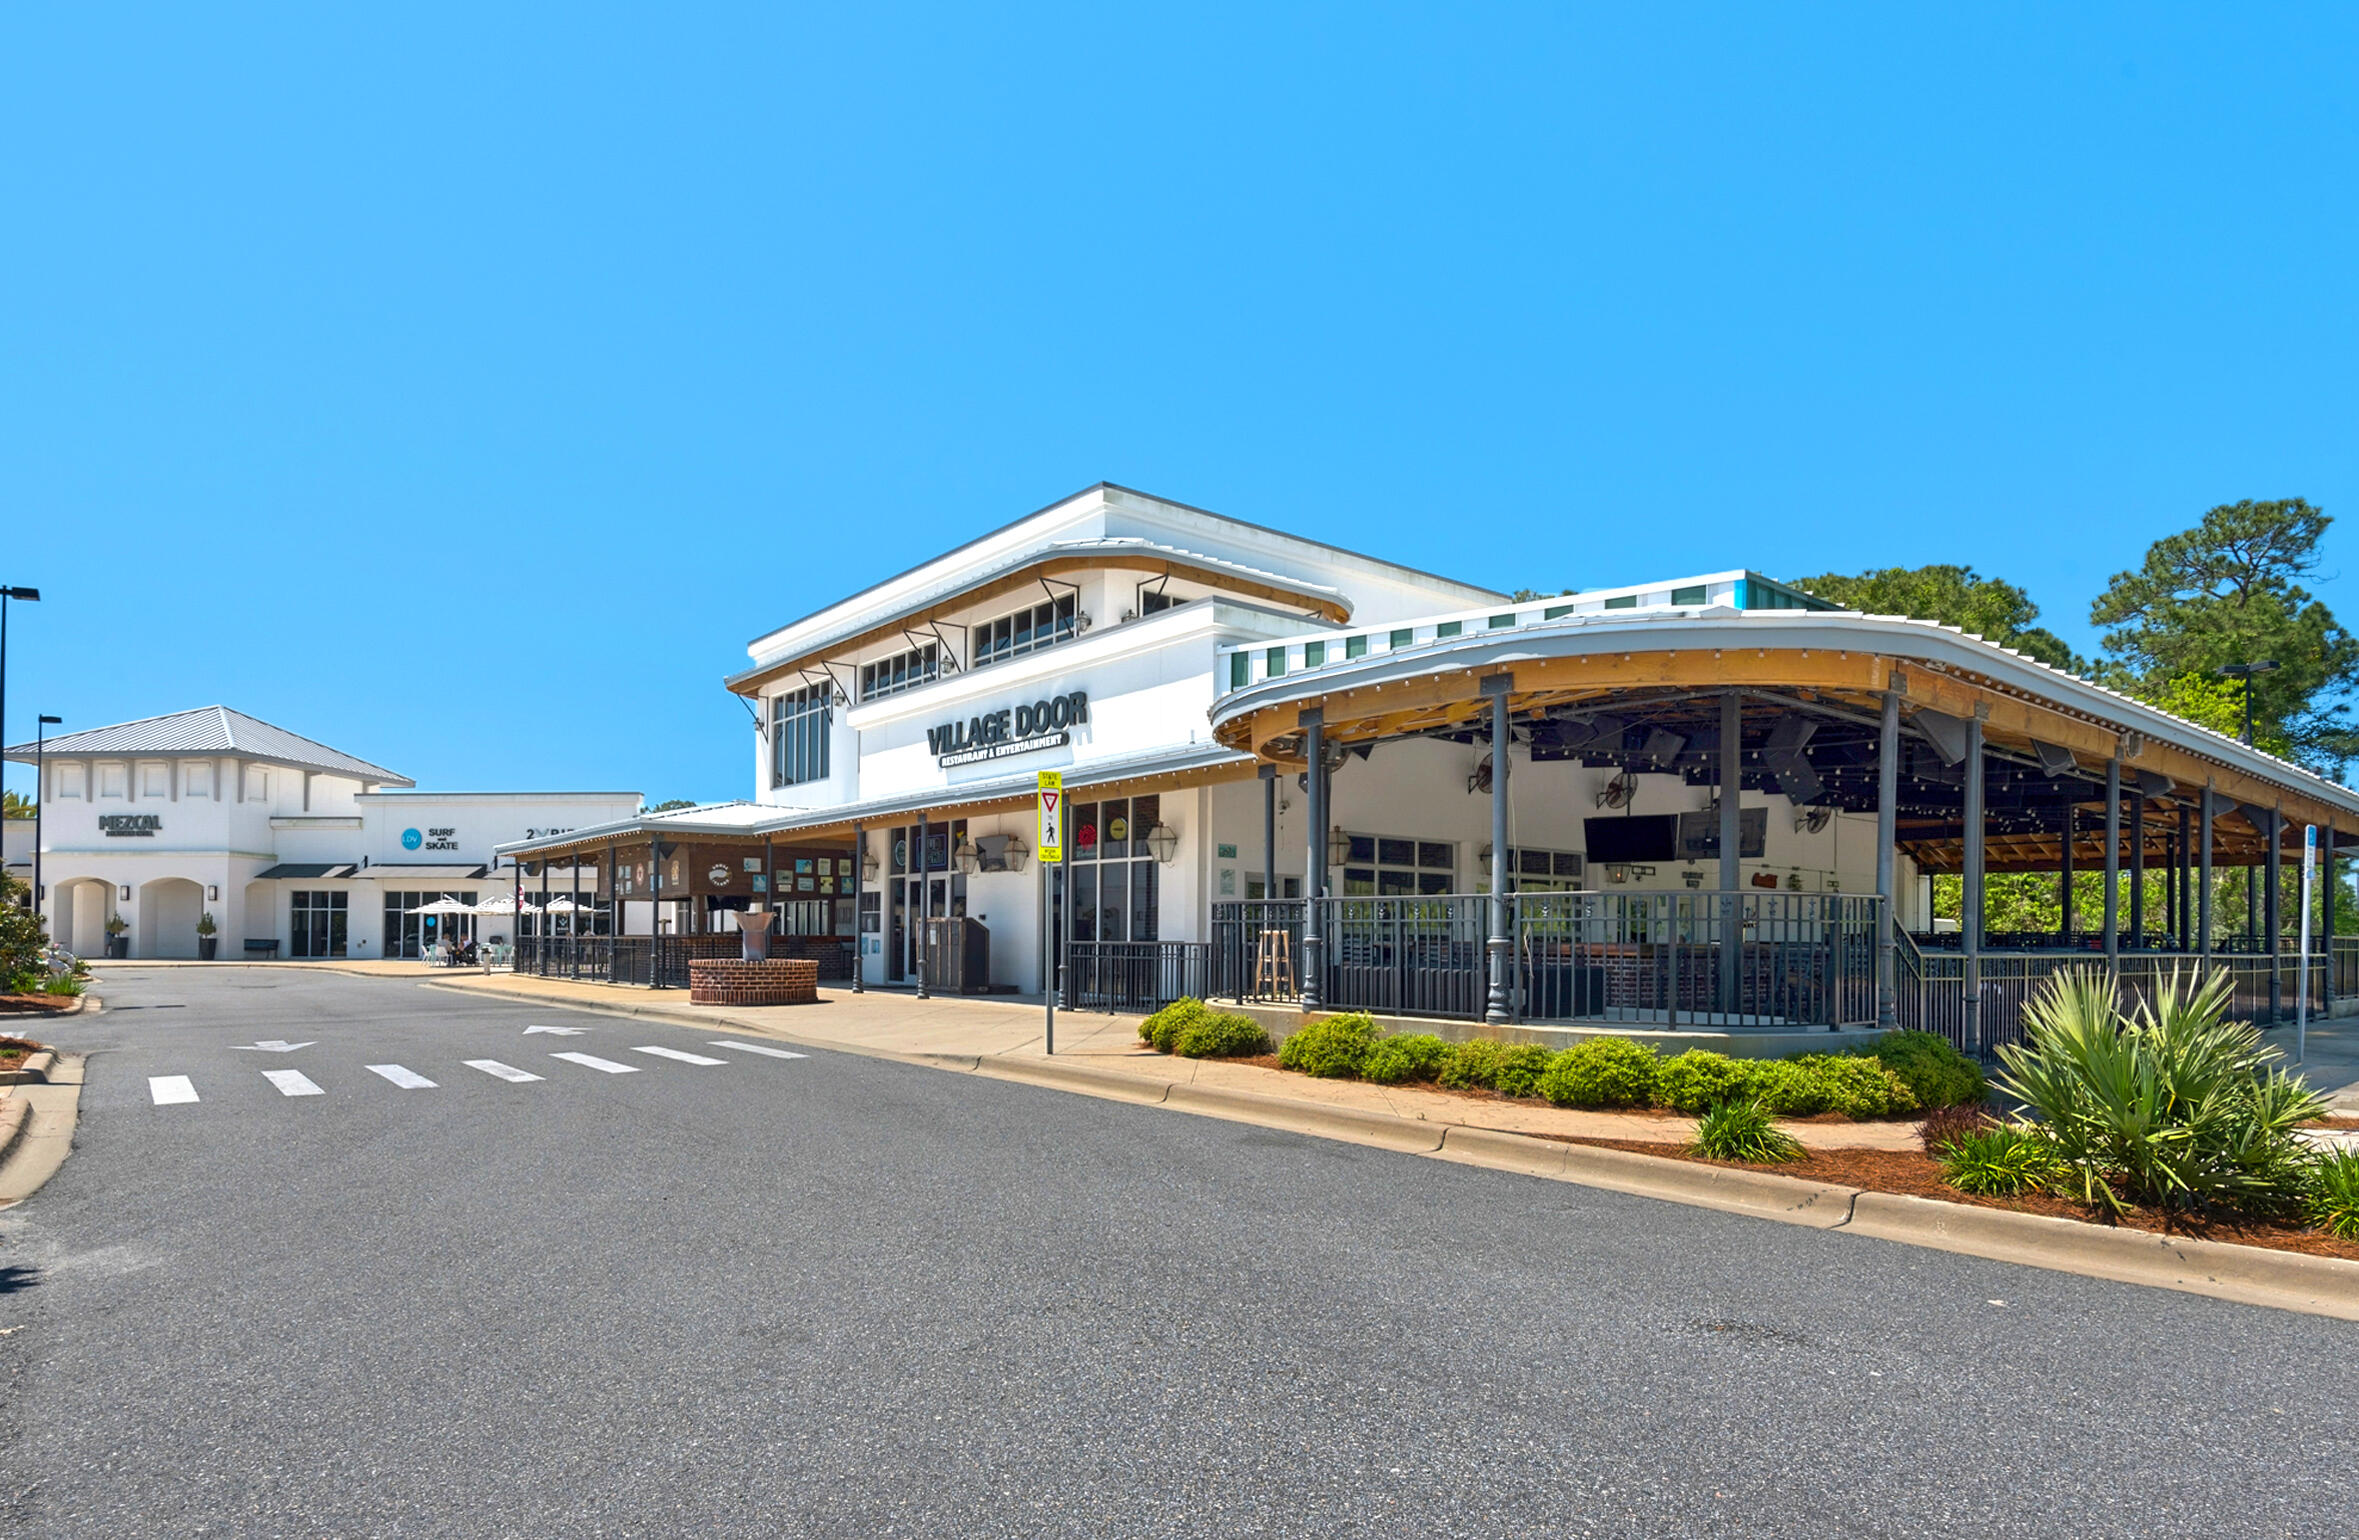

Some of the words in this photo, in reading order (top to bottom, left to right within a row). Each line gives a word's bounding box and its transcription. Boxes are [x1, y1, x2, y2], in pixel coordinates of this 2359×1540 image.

[927, 709, 1010, 756] VILLAGE
[1015, 691, 1087, 737] DOOR
[941, 749, 988, 767] RESTAURANT
[995, 733, 1062, 757] ENTERTAINMENT
[99, 815, 162, 830] MEZCAL
[428, 828, 456, 837] SURF
[425, 842, 459, 850] SKATE
